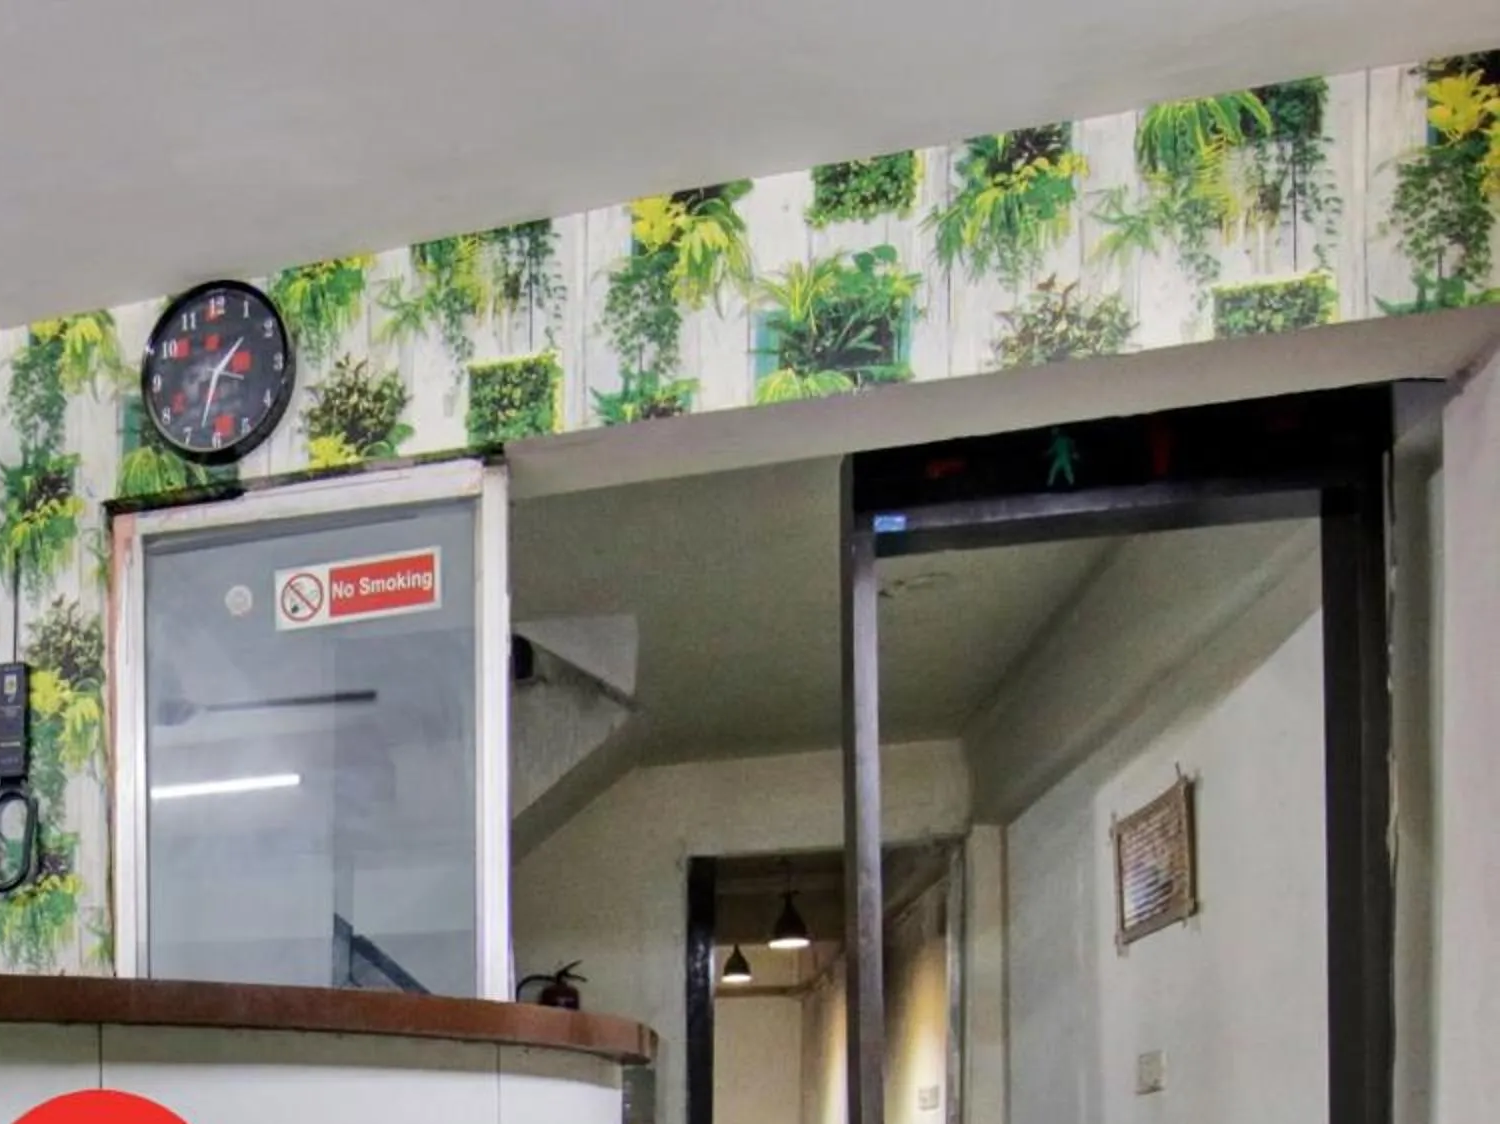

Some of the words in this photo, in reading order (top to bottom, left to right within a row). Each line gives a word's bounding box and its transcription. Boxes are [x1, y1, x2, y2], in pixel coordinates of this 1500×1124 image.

[209, 297, 225, 314] 12
[243, 301, 250, 318] 1
[181, 312, 196, 330] 11
[263, 319, 273, 336] 2
[162, 340, 178, 359] 10
[274, 353, 283, 370] 3
[153, 375, 162, 393] 9
[263, 390, 271, 408] 4
[162, 409, 171, 423] 8
[241, 417, 250, 433] 5
[183, 427, 192, 445] 7
[212, 432, 221, 448] 6
[332, 581, 355, 599] No
[359, 570, 433, 595] Smoking
